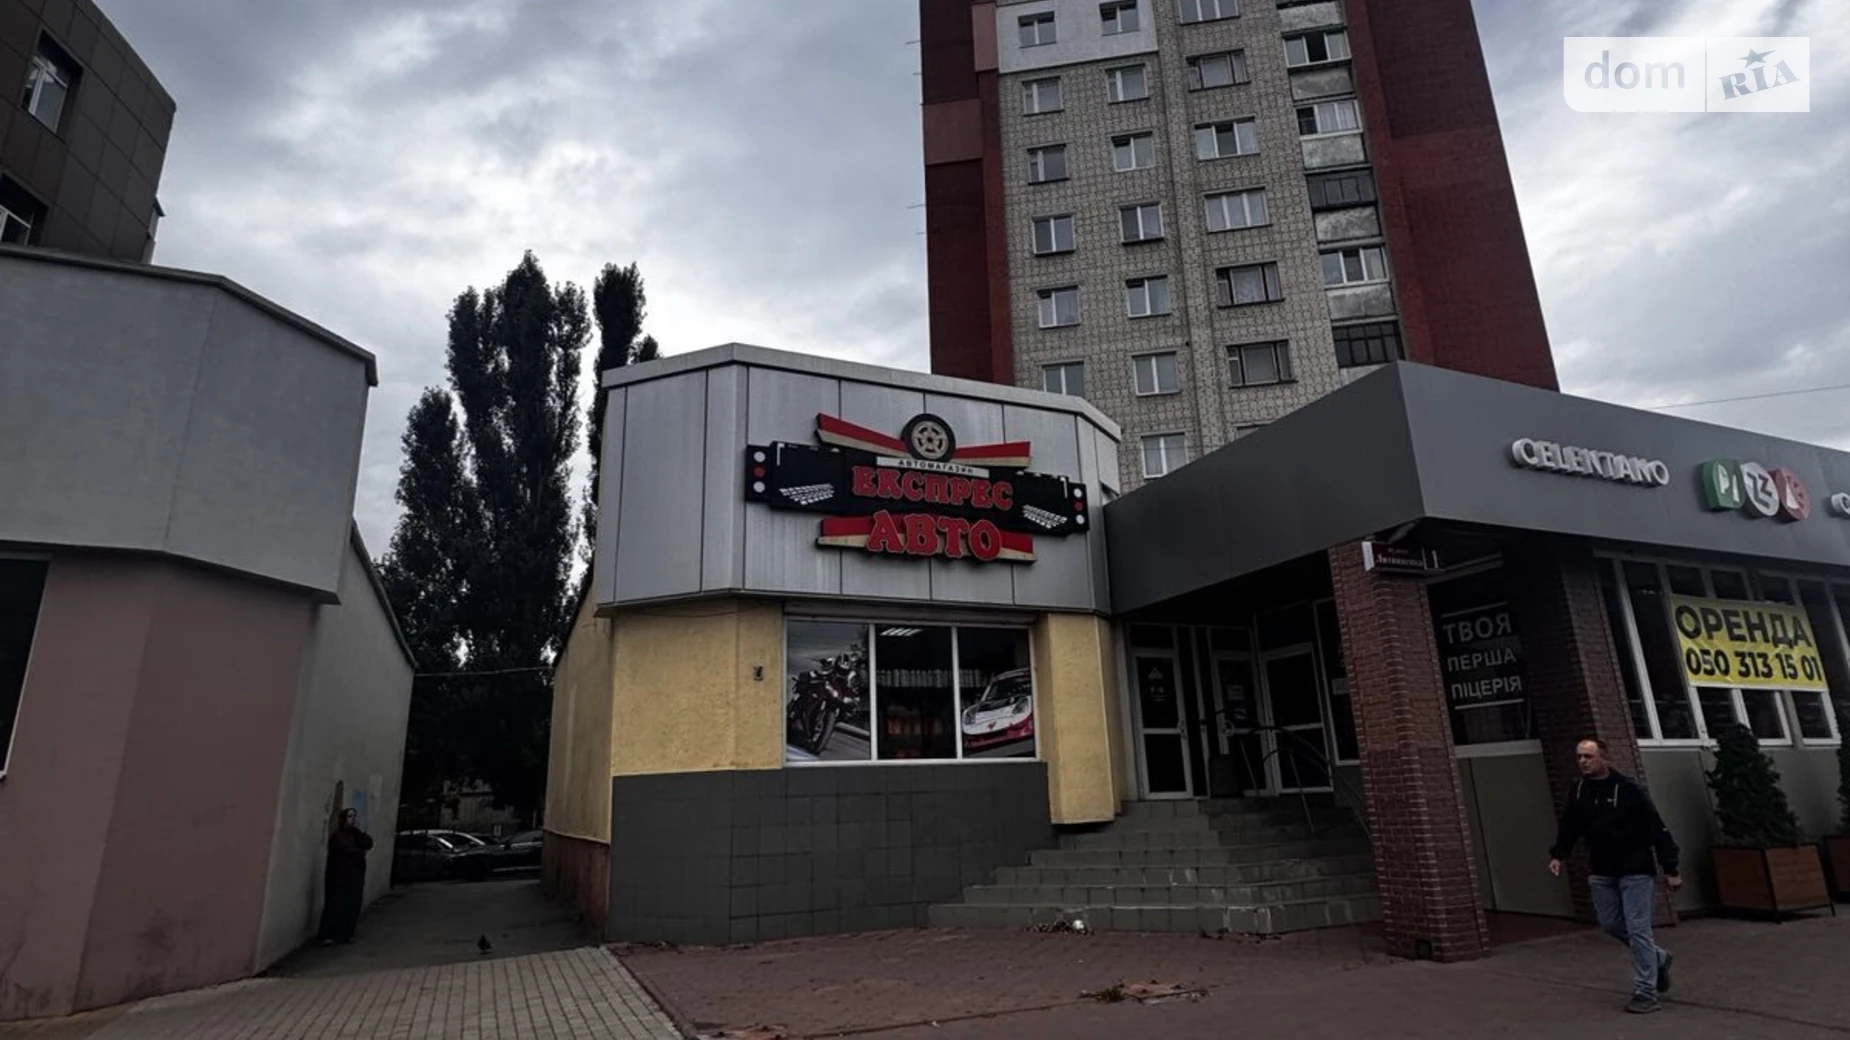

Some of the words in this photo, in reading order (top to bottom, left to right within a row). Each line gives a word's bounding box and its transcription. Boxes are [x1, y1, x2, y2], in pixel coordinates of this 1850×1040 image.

[898, 458, 974, 475] АВТОМАГАЗИН
[1512, 437, 1670, 487] CELENTANO
[852, 465, 1014, 511] ЕКСПРЕС
[866, 509, 1002, 561] АВТО
[1443, 613, 1512, 644] ТВОЯ
[1675, 604, 1813, 649] ОРЕНДА
[1447, 647, 1517, 672] ПЕРША
[1686, 647, 1730, 677] 050
[1734, 651, 1774, 679] 313
[1776, 653, 1798, 680] 15
[1801, 655, 1822, 682] 01
[1451, 675, 1522, 701] ПІЦЕРІЯ
